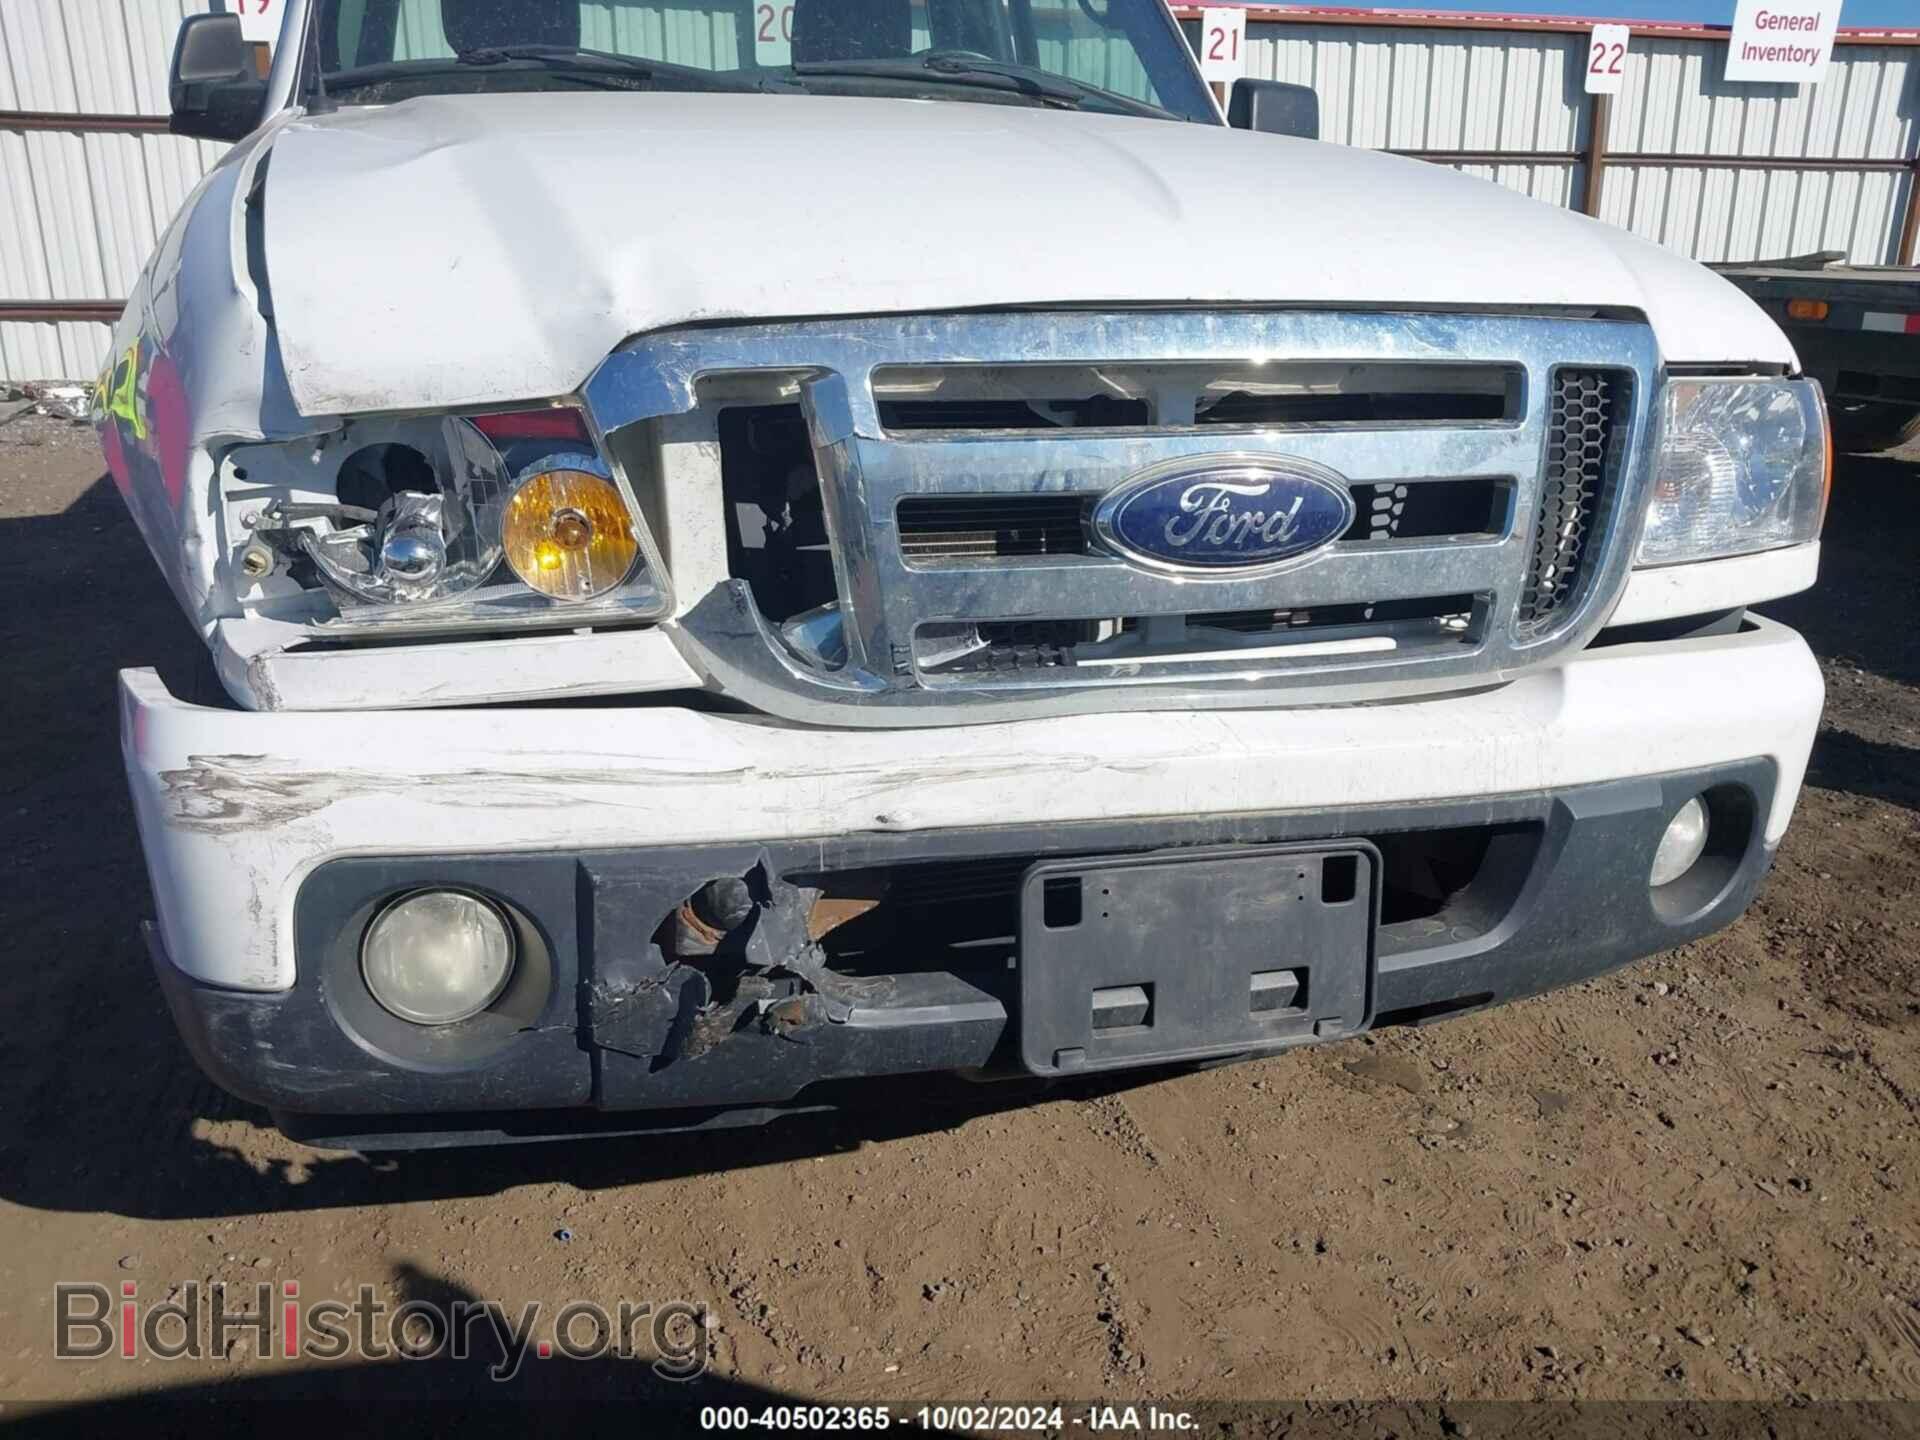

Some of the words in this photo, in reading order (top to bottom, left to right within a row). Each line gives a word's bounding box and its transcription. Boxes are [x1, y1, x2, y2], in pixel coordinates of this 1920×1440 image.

[1755, 9, 1821, 32] General
[1209, 27, 1238, 61] 21
[1590, 42, 1625, 74] 22
[1741, 41, 1820, 67] Inventory
[1164, 482, 1303, 547] Ford
